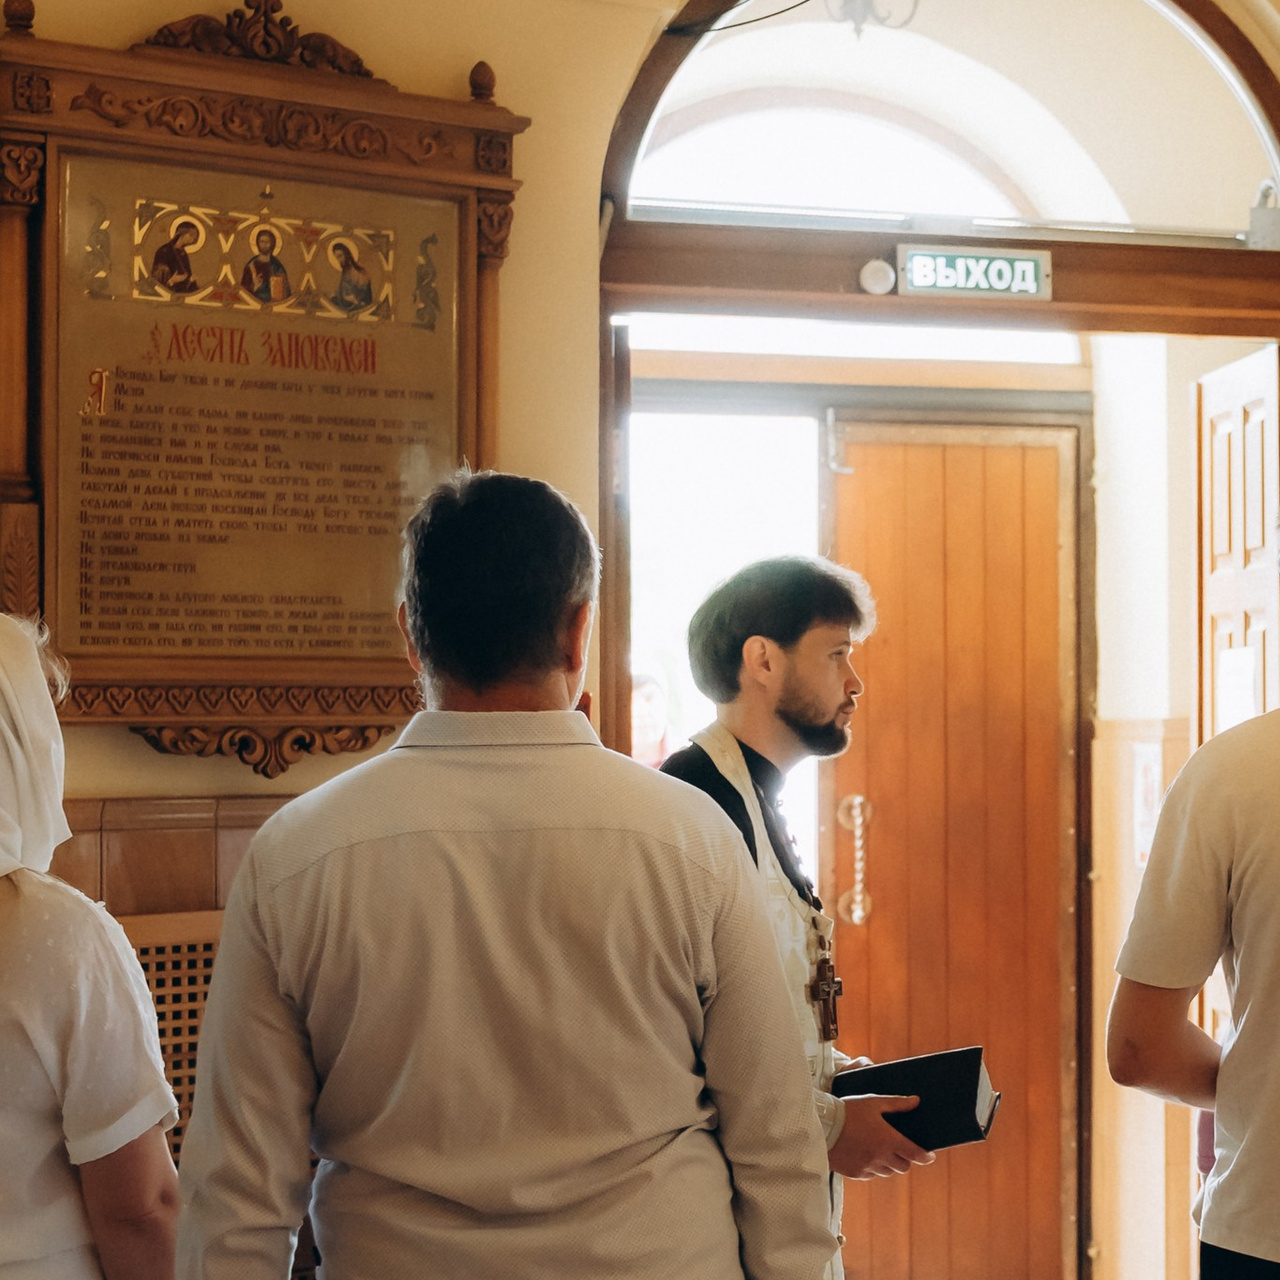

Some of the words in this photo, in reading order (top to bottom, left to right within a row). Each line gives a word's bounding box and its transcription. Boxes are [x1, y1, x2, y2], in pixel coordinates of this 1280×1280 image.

[911, 255, 1038, 294] ВЫХОД
[167, 323, 250, 366] ДЕСЯТЬ
[260, 329, 377, 375] ЗАПОВЕДЕЙ
